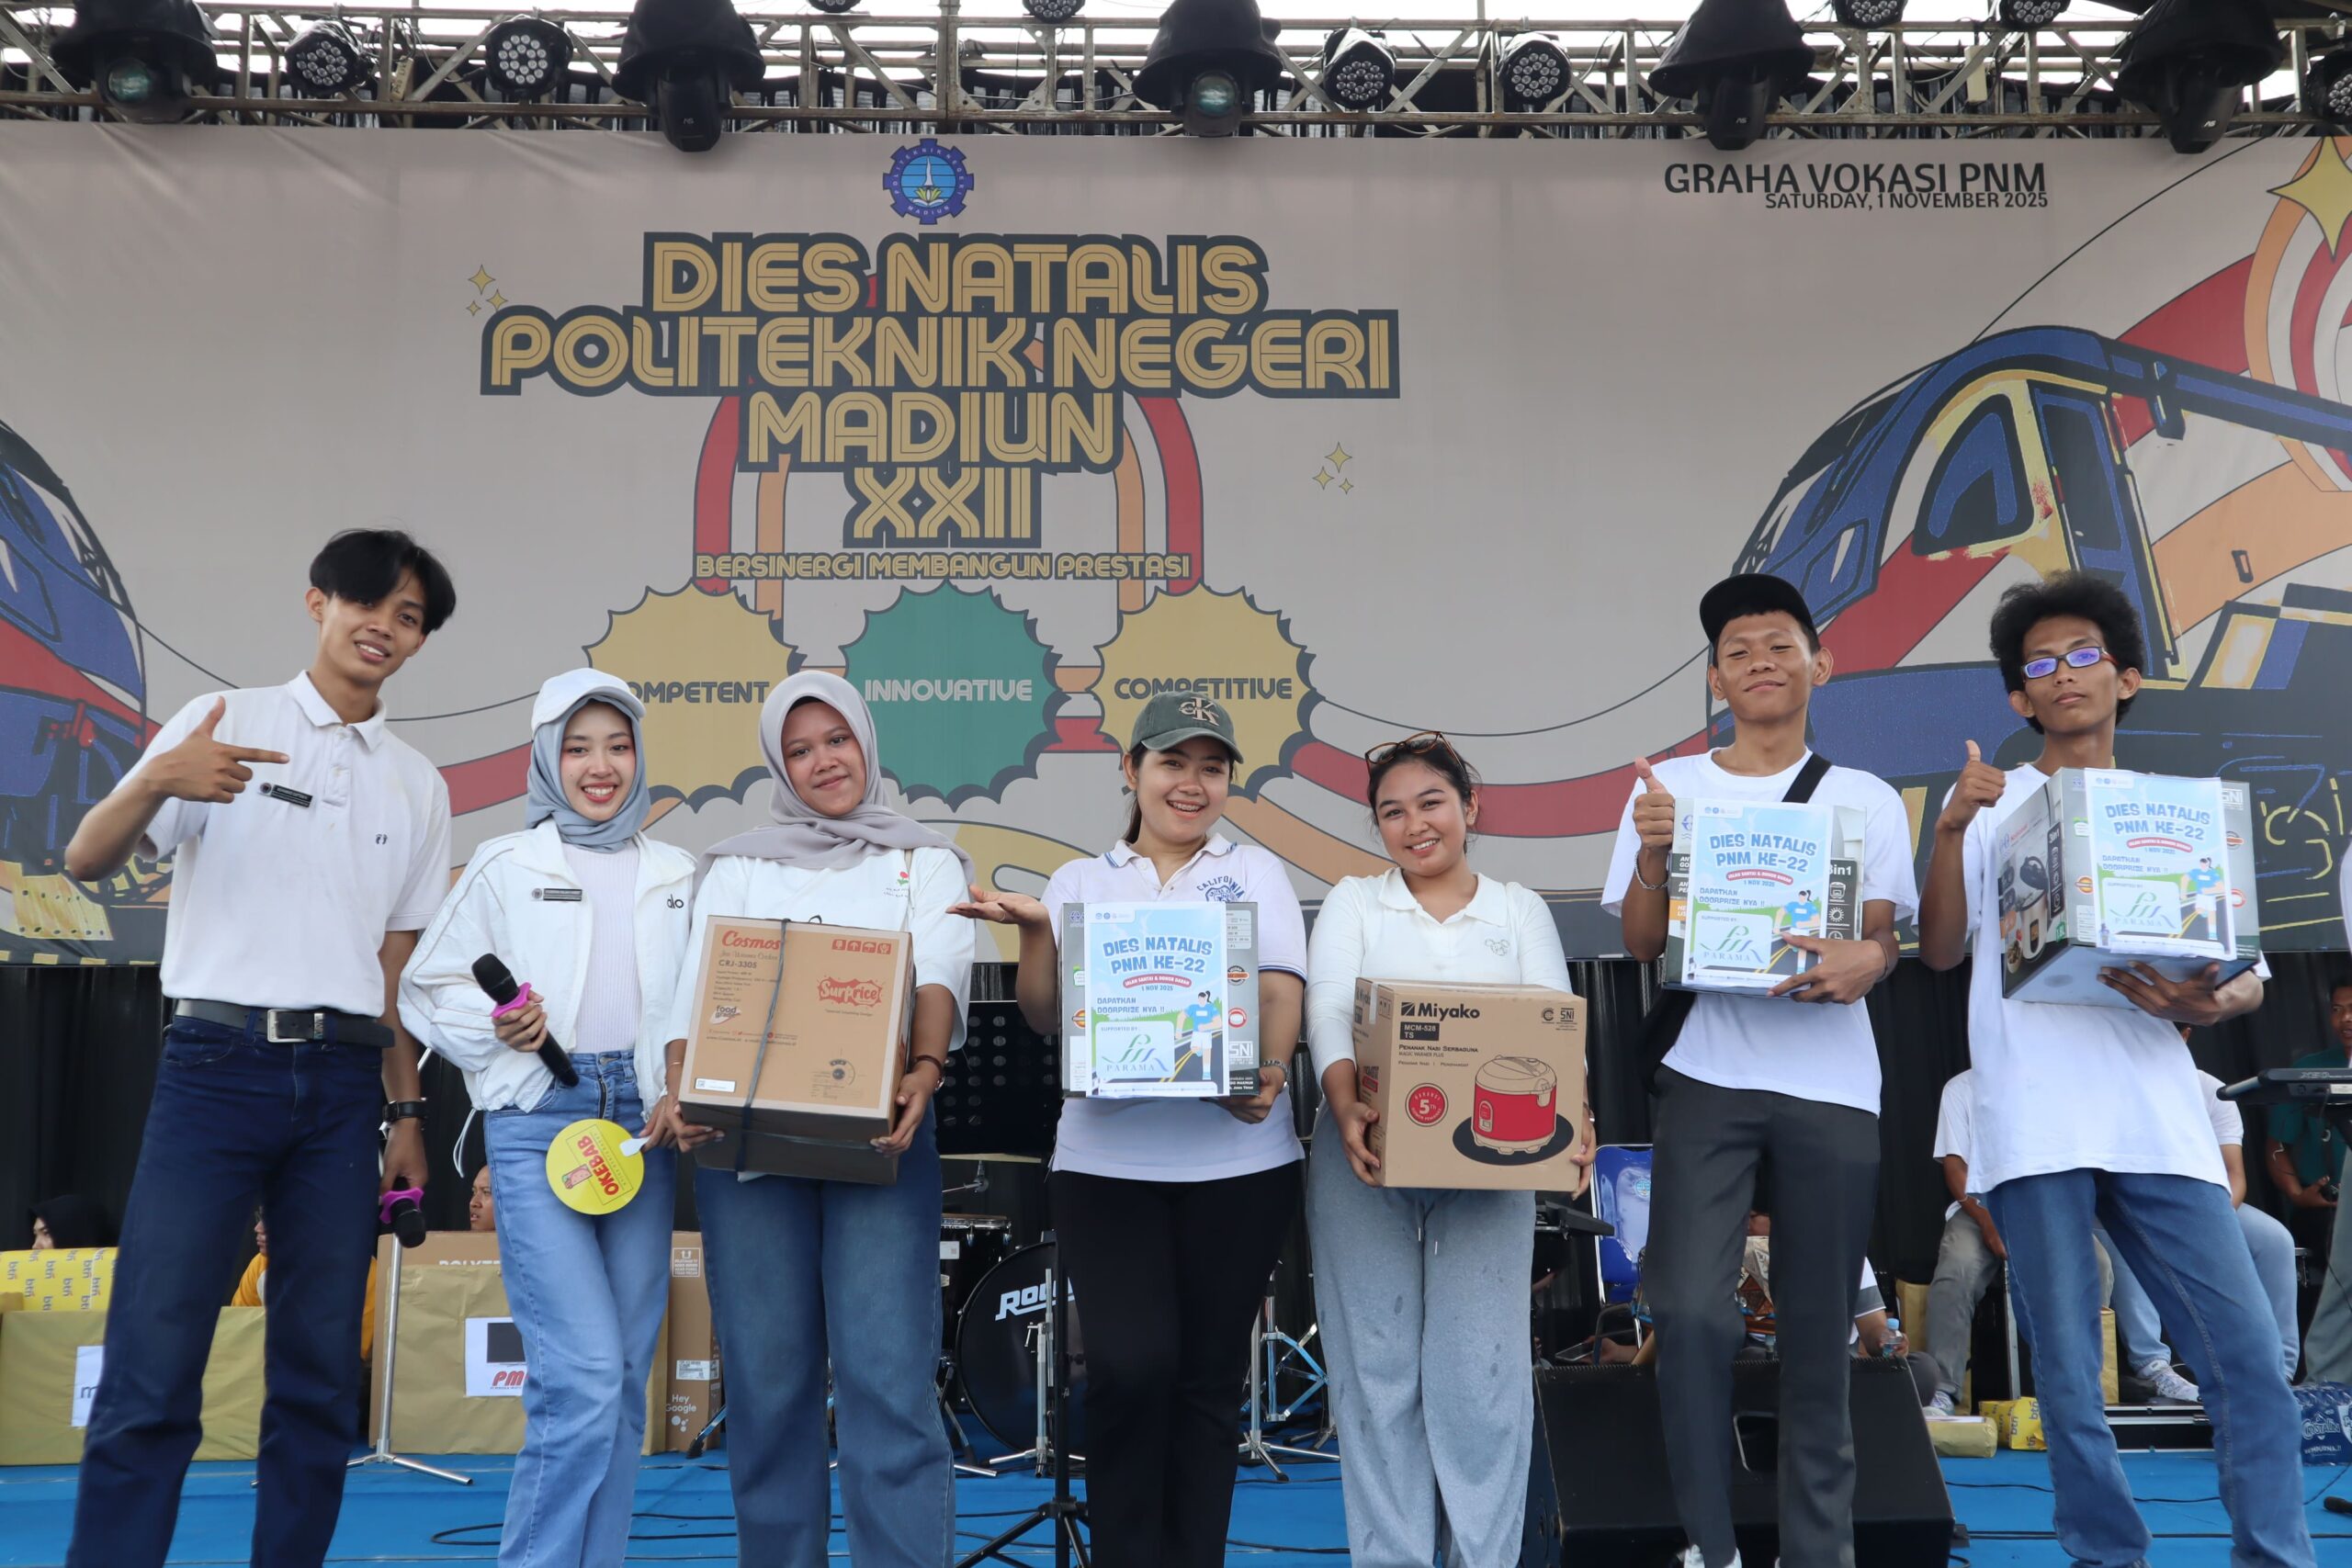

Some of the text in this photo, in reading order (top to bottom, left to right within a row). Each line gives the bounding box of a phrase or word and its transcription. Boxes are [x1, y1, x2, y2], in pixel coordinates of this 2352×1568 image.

[1664, 163, 2045, 194] GRAHA VOKASI PNM
[1765, 192, 2048, 211] SATURDAY, 1 NOVEMBER 2025
[653, 241, 1261, 316] DIES NATALIS
[490, 314, 1391, 390] POLITEKNIK NEGERI
[748, 390, 1114, 464] MADIUN
[854, 466, 1032, 540] XXII
[695, 554, 1190, 579] BERSINERGI MEMBANGUN PRESTASI
[627, 681, 770, 704] OMPETENT
[865, 679, 1033, 703] INNOVATIVE
[1114, 677, 1293, 700] COMPETITIVE
[2105, 803, 2211, 825] DIES NATALIS
[2114, 820, 2205, 840] PNM KE-22
[1710, 833, 1817, 856] DIES NATALIS
[1716, 852, 1808, 872] PNM KE-22
[721, 930, 781, 950] Cosmos
[1102, 936, 1213, 956] DIES NATALIS
[1111, 955, 1205, 974] PNM KE-22
[1703, 952, 1750, 962] PARAMA
[1418, 1002, 1480, 1021] Miyako
[1106, 1064, 1155, 1072] PARAMA
[1419, 1099, 1430, 1115] 5
[492, 1371, 526, 1386] PM
[665, 1404, 697, 1414] Google
[672, 1394, 690, 1404] Hey
